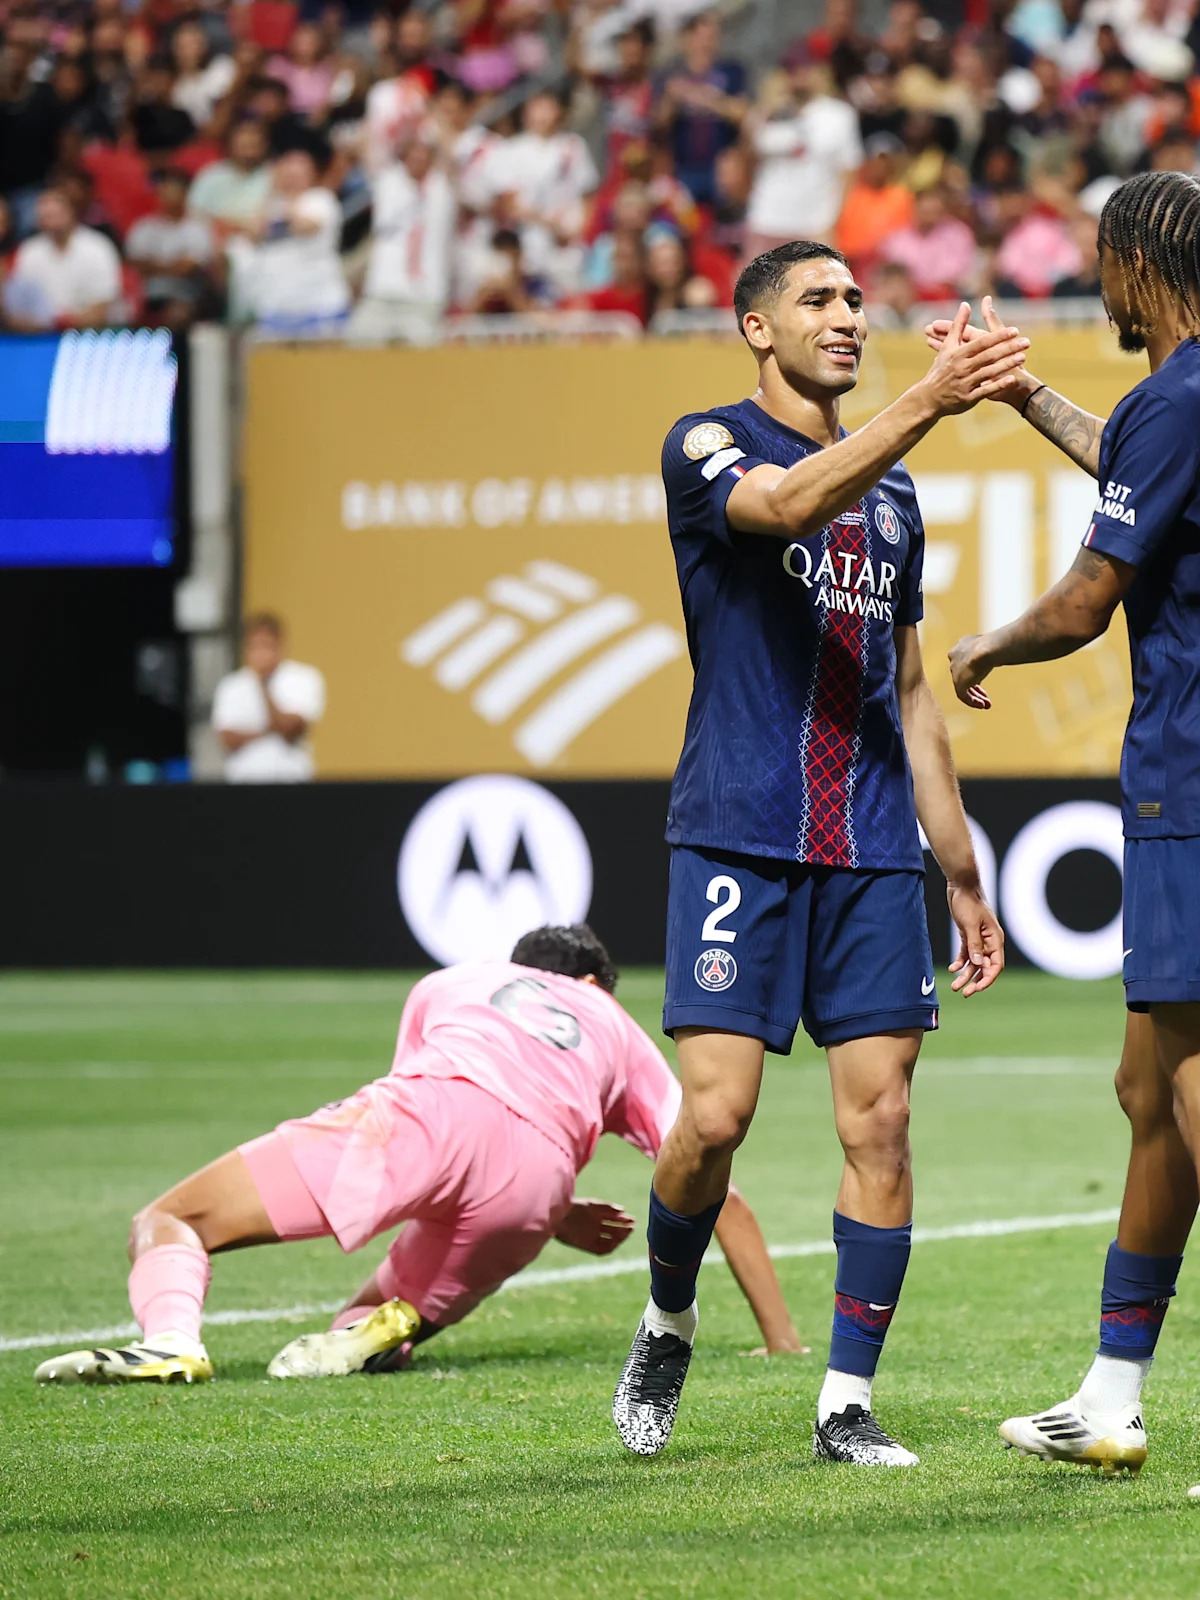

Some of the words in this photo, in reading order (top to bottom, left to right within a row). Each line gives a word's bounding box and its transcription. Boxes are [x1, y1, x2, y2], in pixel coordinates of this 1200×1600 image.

[341, 479, 467, 530] BANK
[471, 476, 536, 528] OF
[537, 474, 667, 525] AMER
[1104, 480, 1133, 503] SIT
[1094, 496, 1136, 527] ANDA
[782, 542, 896, 599] QATAR
[814, 586, 893, 623] AIRWAYS
[701, 874, 741, 943] 2
[702, 951, 731, 963] PARIS
